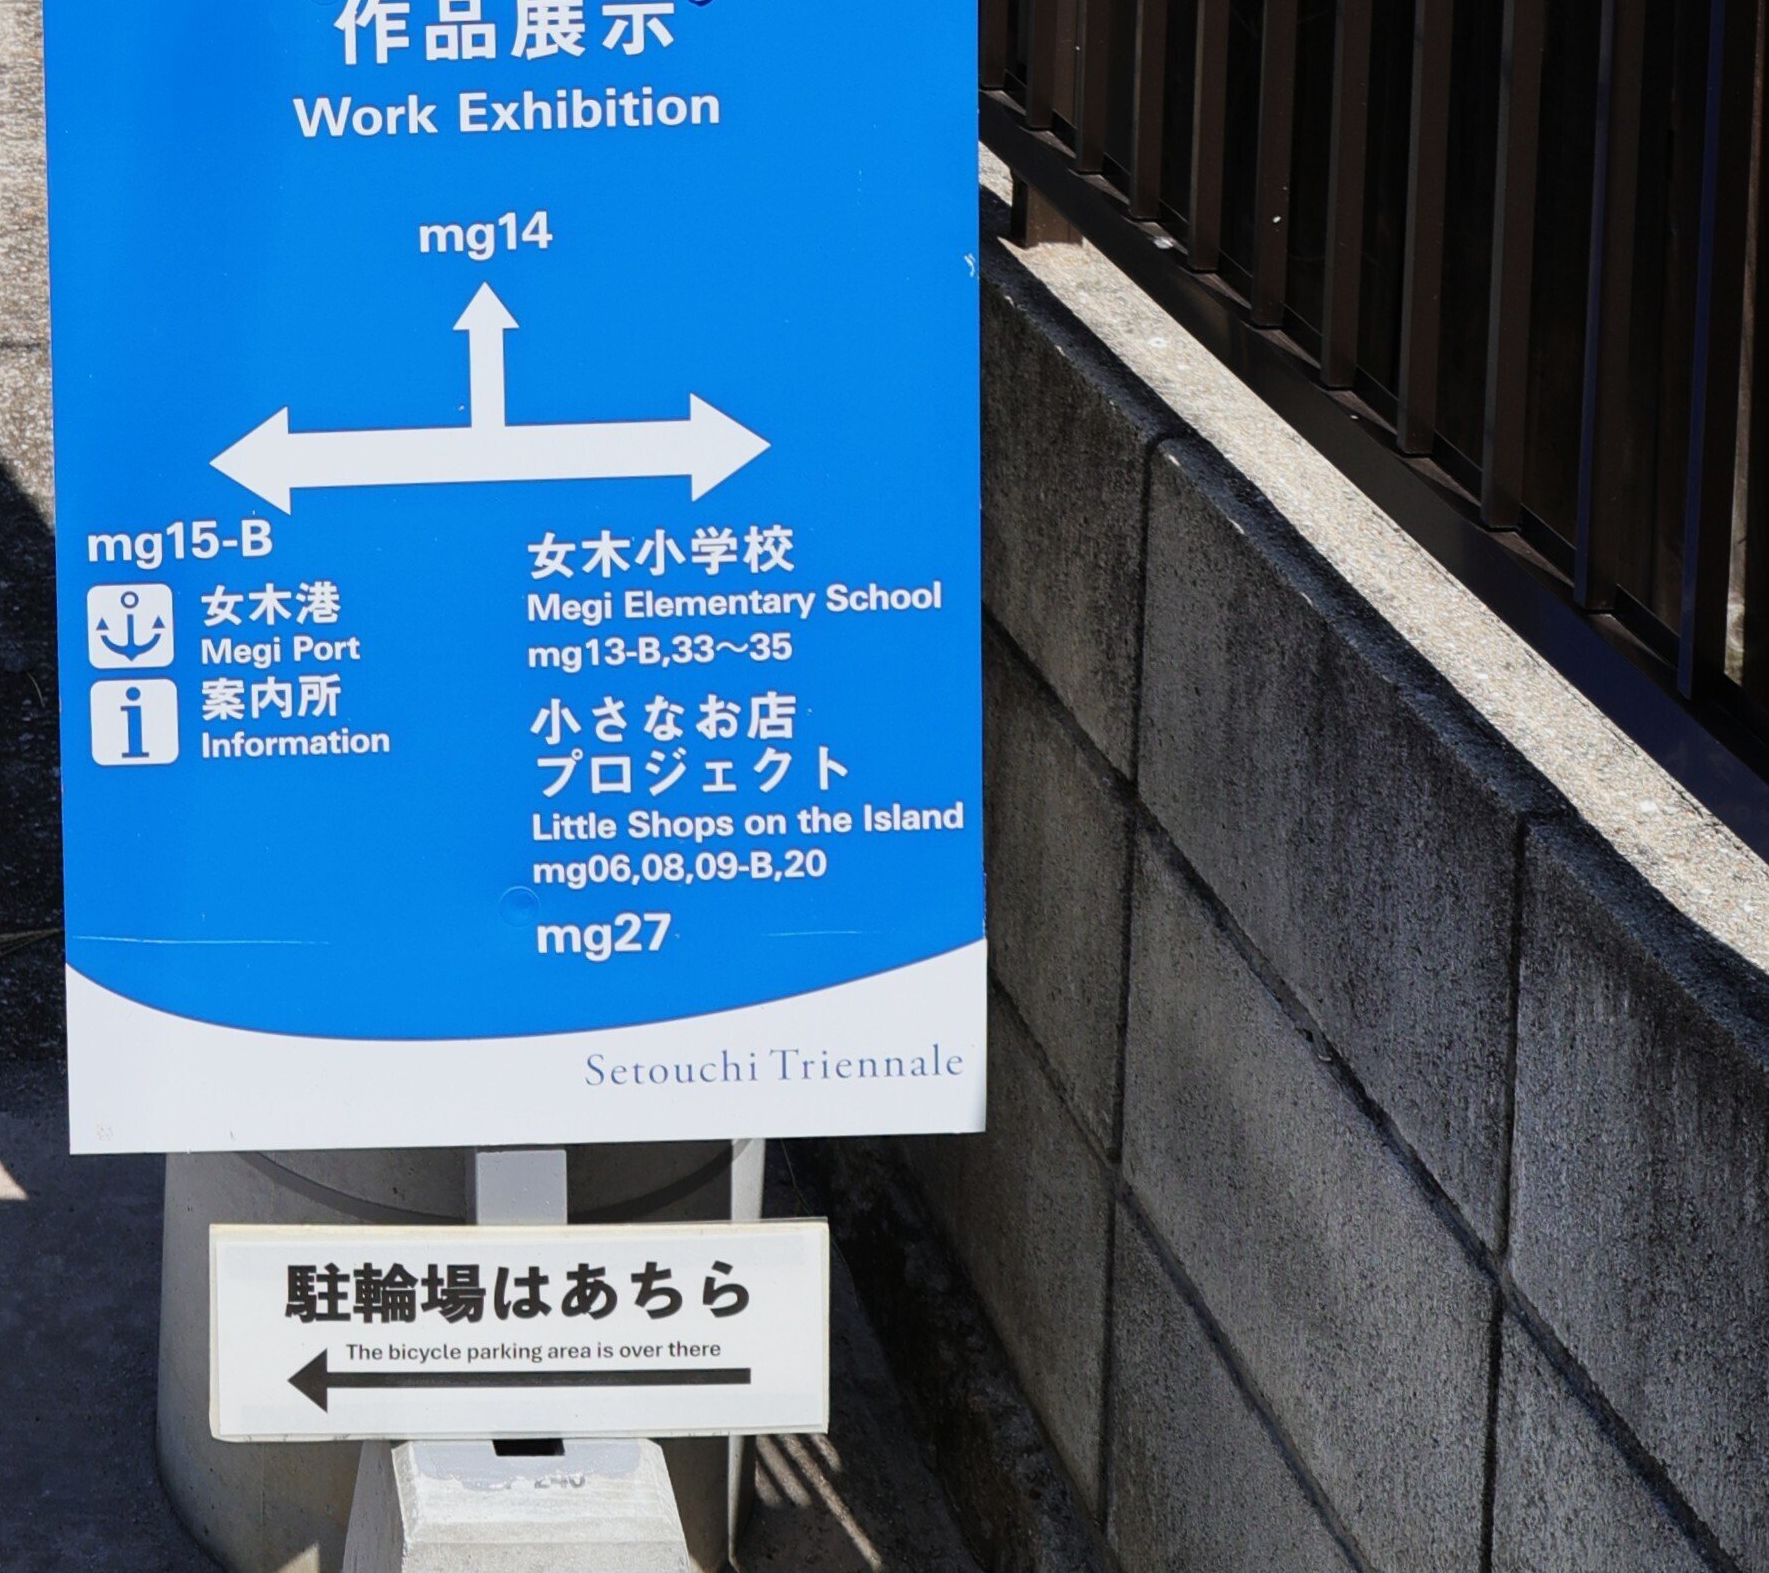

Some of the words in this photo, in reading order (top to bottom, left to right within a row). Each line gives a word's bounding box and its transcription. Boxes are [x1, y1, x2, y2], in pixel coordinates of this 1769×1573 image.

[293, 95, 437, 137] Work
[460, 87, 719, 131] Exhibition
[420, 211, 552, 260] mg14
[88, 519, 272, 569] mg15-B
[528, 525, 794, 579] 女木小学校
[202, 581, 340, 626] 女木港
[528, 592, 611, 626] Megi
[625, 591, 815, 618] Elementary
[827, 581, 941, 611] School
[202, 637, 280, 668] Megi
[294, 636, 360, 661] Port
[202, 674, 341, 720] 案内所
[531, 691, 796, 744] 小さなお店
[203, 728, 389, 757] Information
[538, 747, 847, 797] プロジェクト
[533, 812, 616, 840] Little
[629, 811, 733, 842] Shops
[745, 815, 786, 835] on
[797, 806, 852, 833] the
[865, 802, 963, 831] Island
[534, 849, 826, 889] mg06,08,09-B,20
[538, 913, 671, 961] mg27
[586, 1049, 757, 1085] Setouchi
[770, 1043, 962, 1080] Triennale
[285, 1261, 749, 1323] 駐輪場はあちら
[346, 1344, 383, 1360] The
[389, 1344, 461, 1364] bicycle
[467, 1343, 543, 1363] parking
[548, 1346, 591, 1359] area
[598, 1342, 614, 1358] is
[619, 1345, 663, 1358] over
[668, 1341, 721, 1357] there
